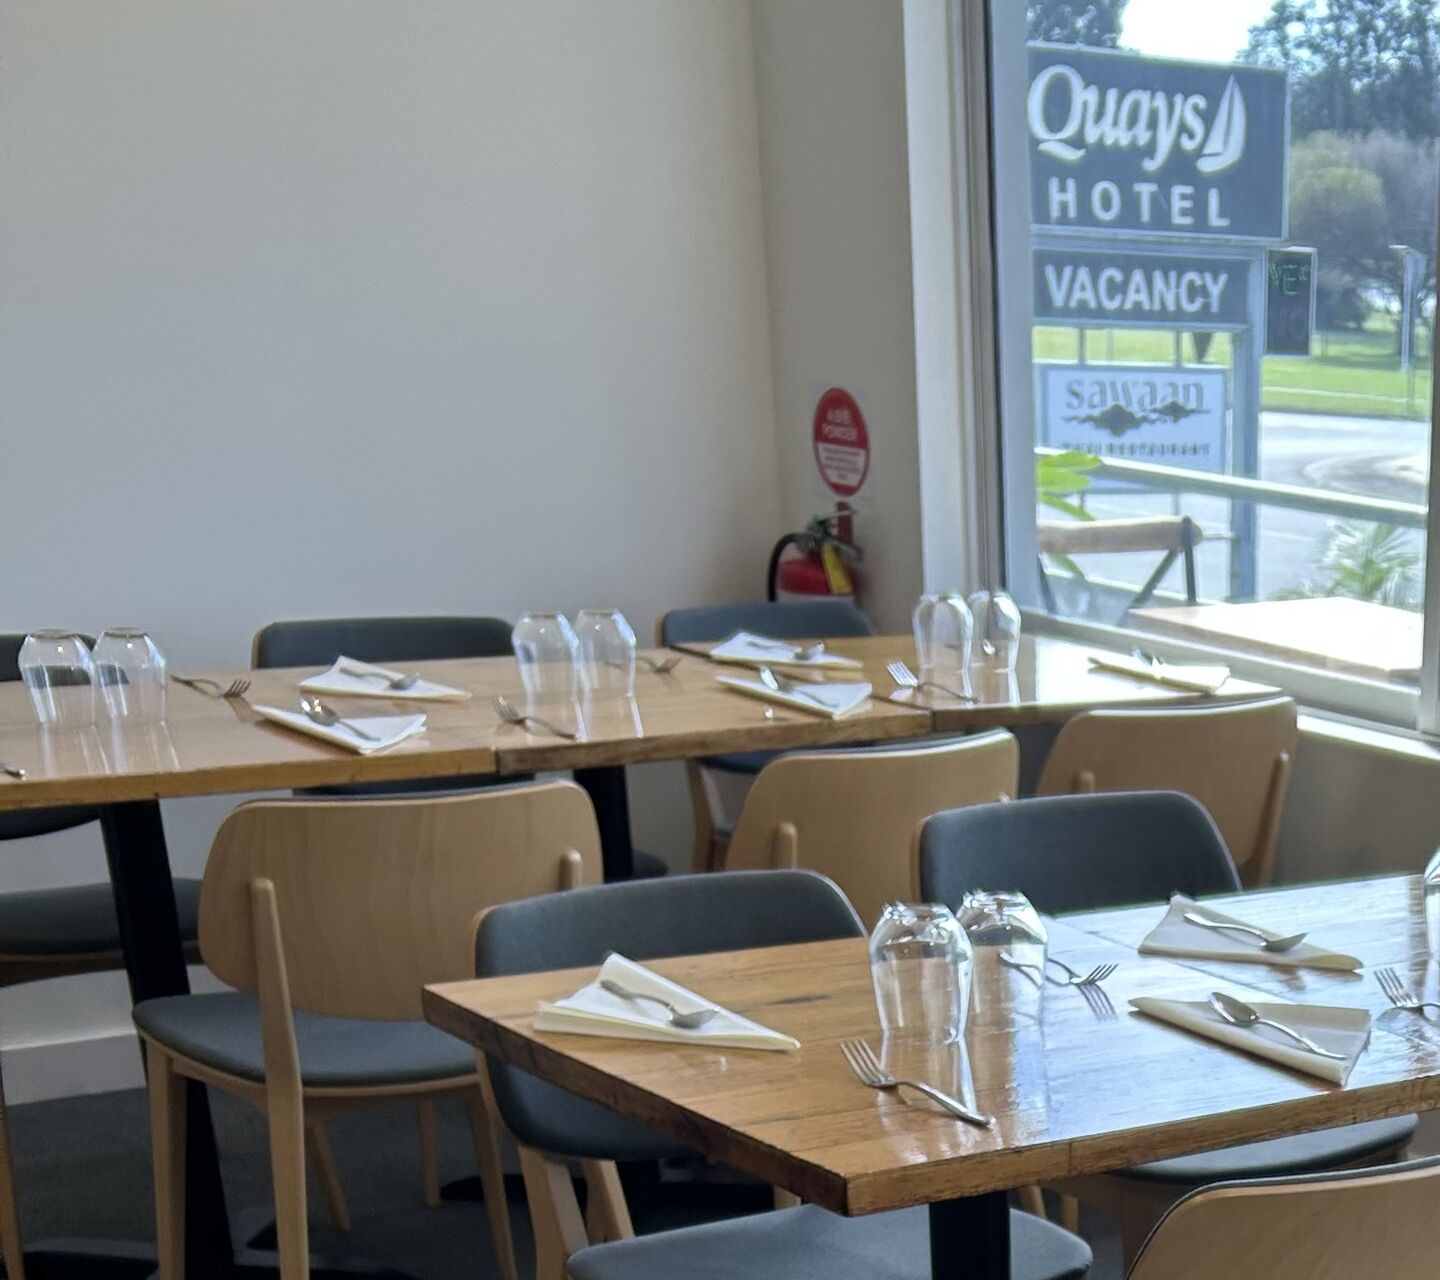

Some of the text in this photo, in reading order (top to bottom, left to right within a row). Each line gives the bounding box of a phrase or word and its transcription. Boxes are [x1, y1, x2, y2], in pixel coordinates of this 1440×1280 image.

[1027, 64, 1208, 171] Quays
[1048, 176, 1231, 227] HOTEL
[1045, 264, 1229, 313] VACANCY
